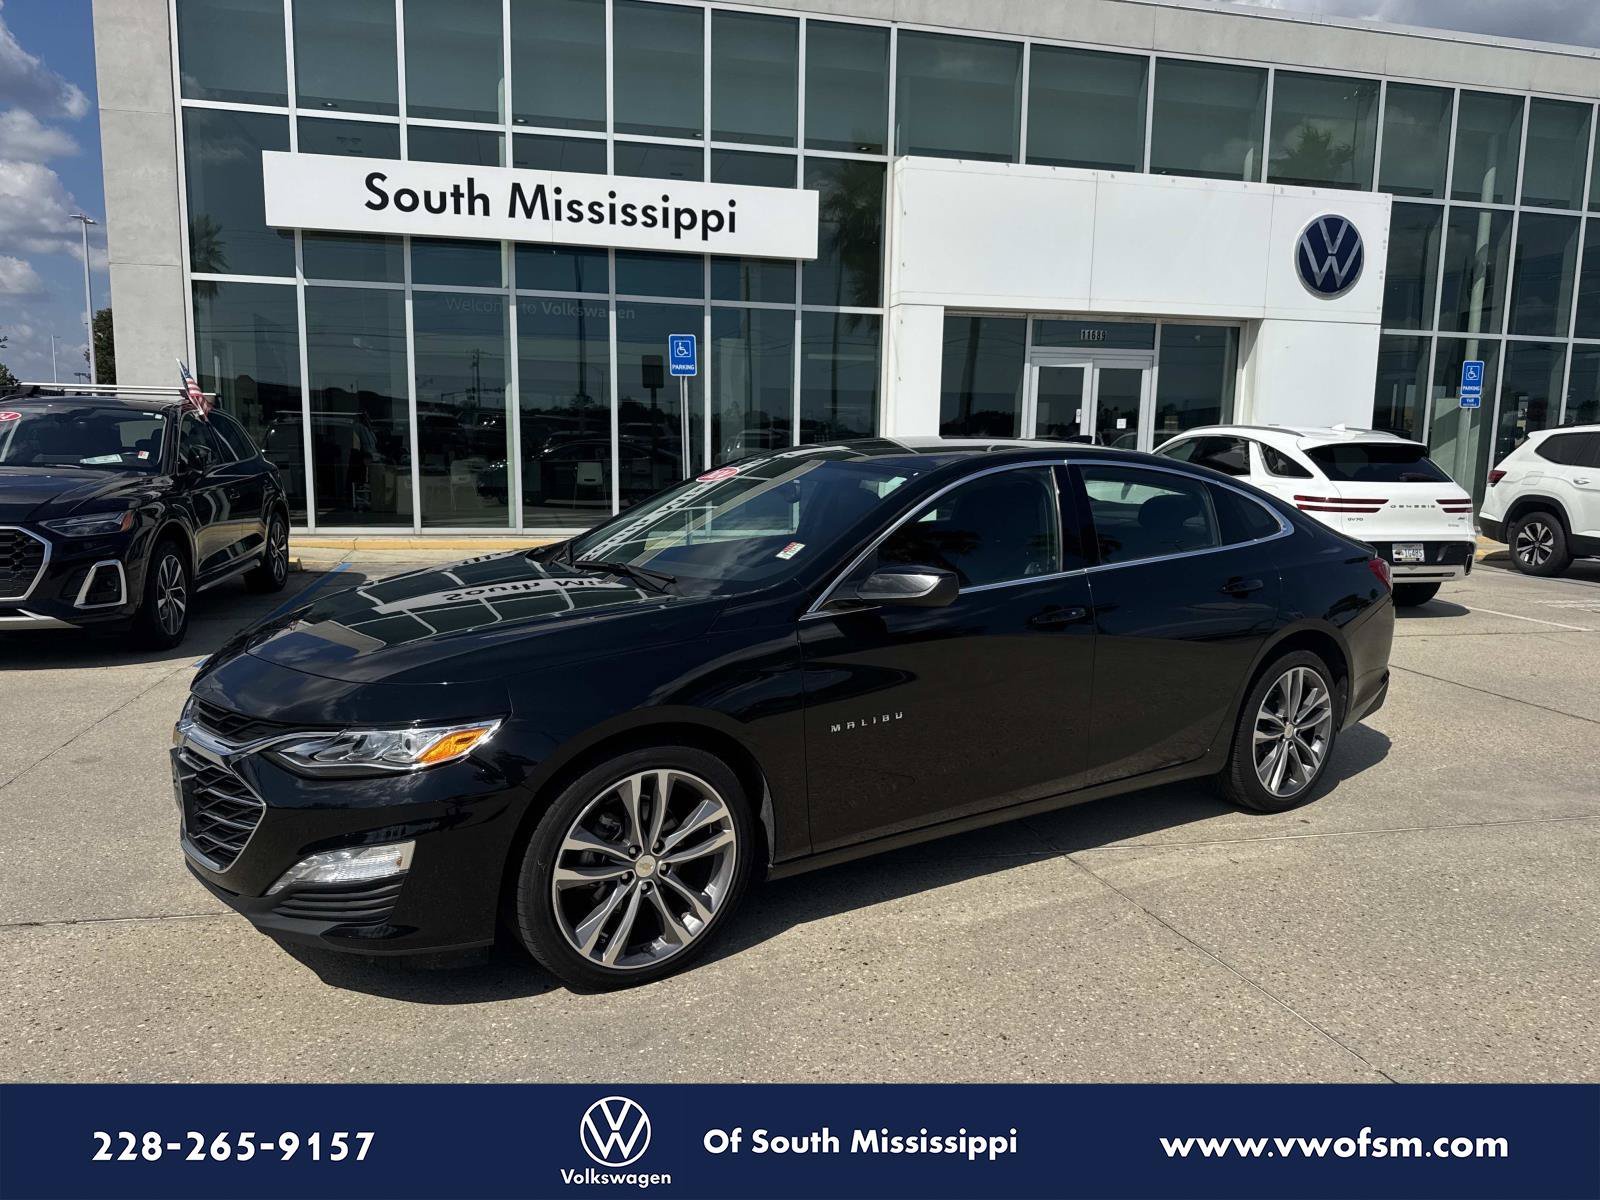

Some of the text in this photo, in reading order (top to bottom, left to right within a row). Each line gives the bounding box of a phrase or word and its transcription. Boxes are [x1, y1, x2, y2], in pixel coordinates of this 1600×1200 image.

[364, 171, 737, 242] South Mississippi
[445, 296, 503, 314] Welcom
[541, 301, 636, 319] Volkswaen
[830, 711, 903, 733] MALIBU
